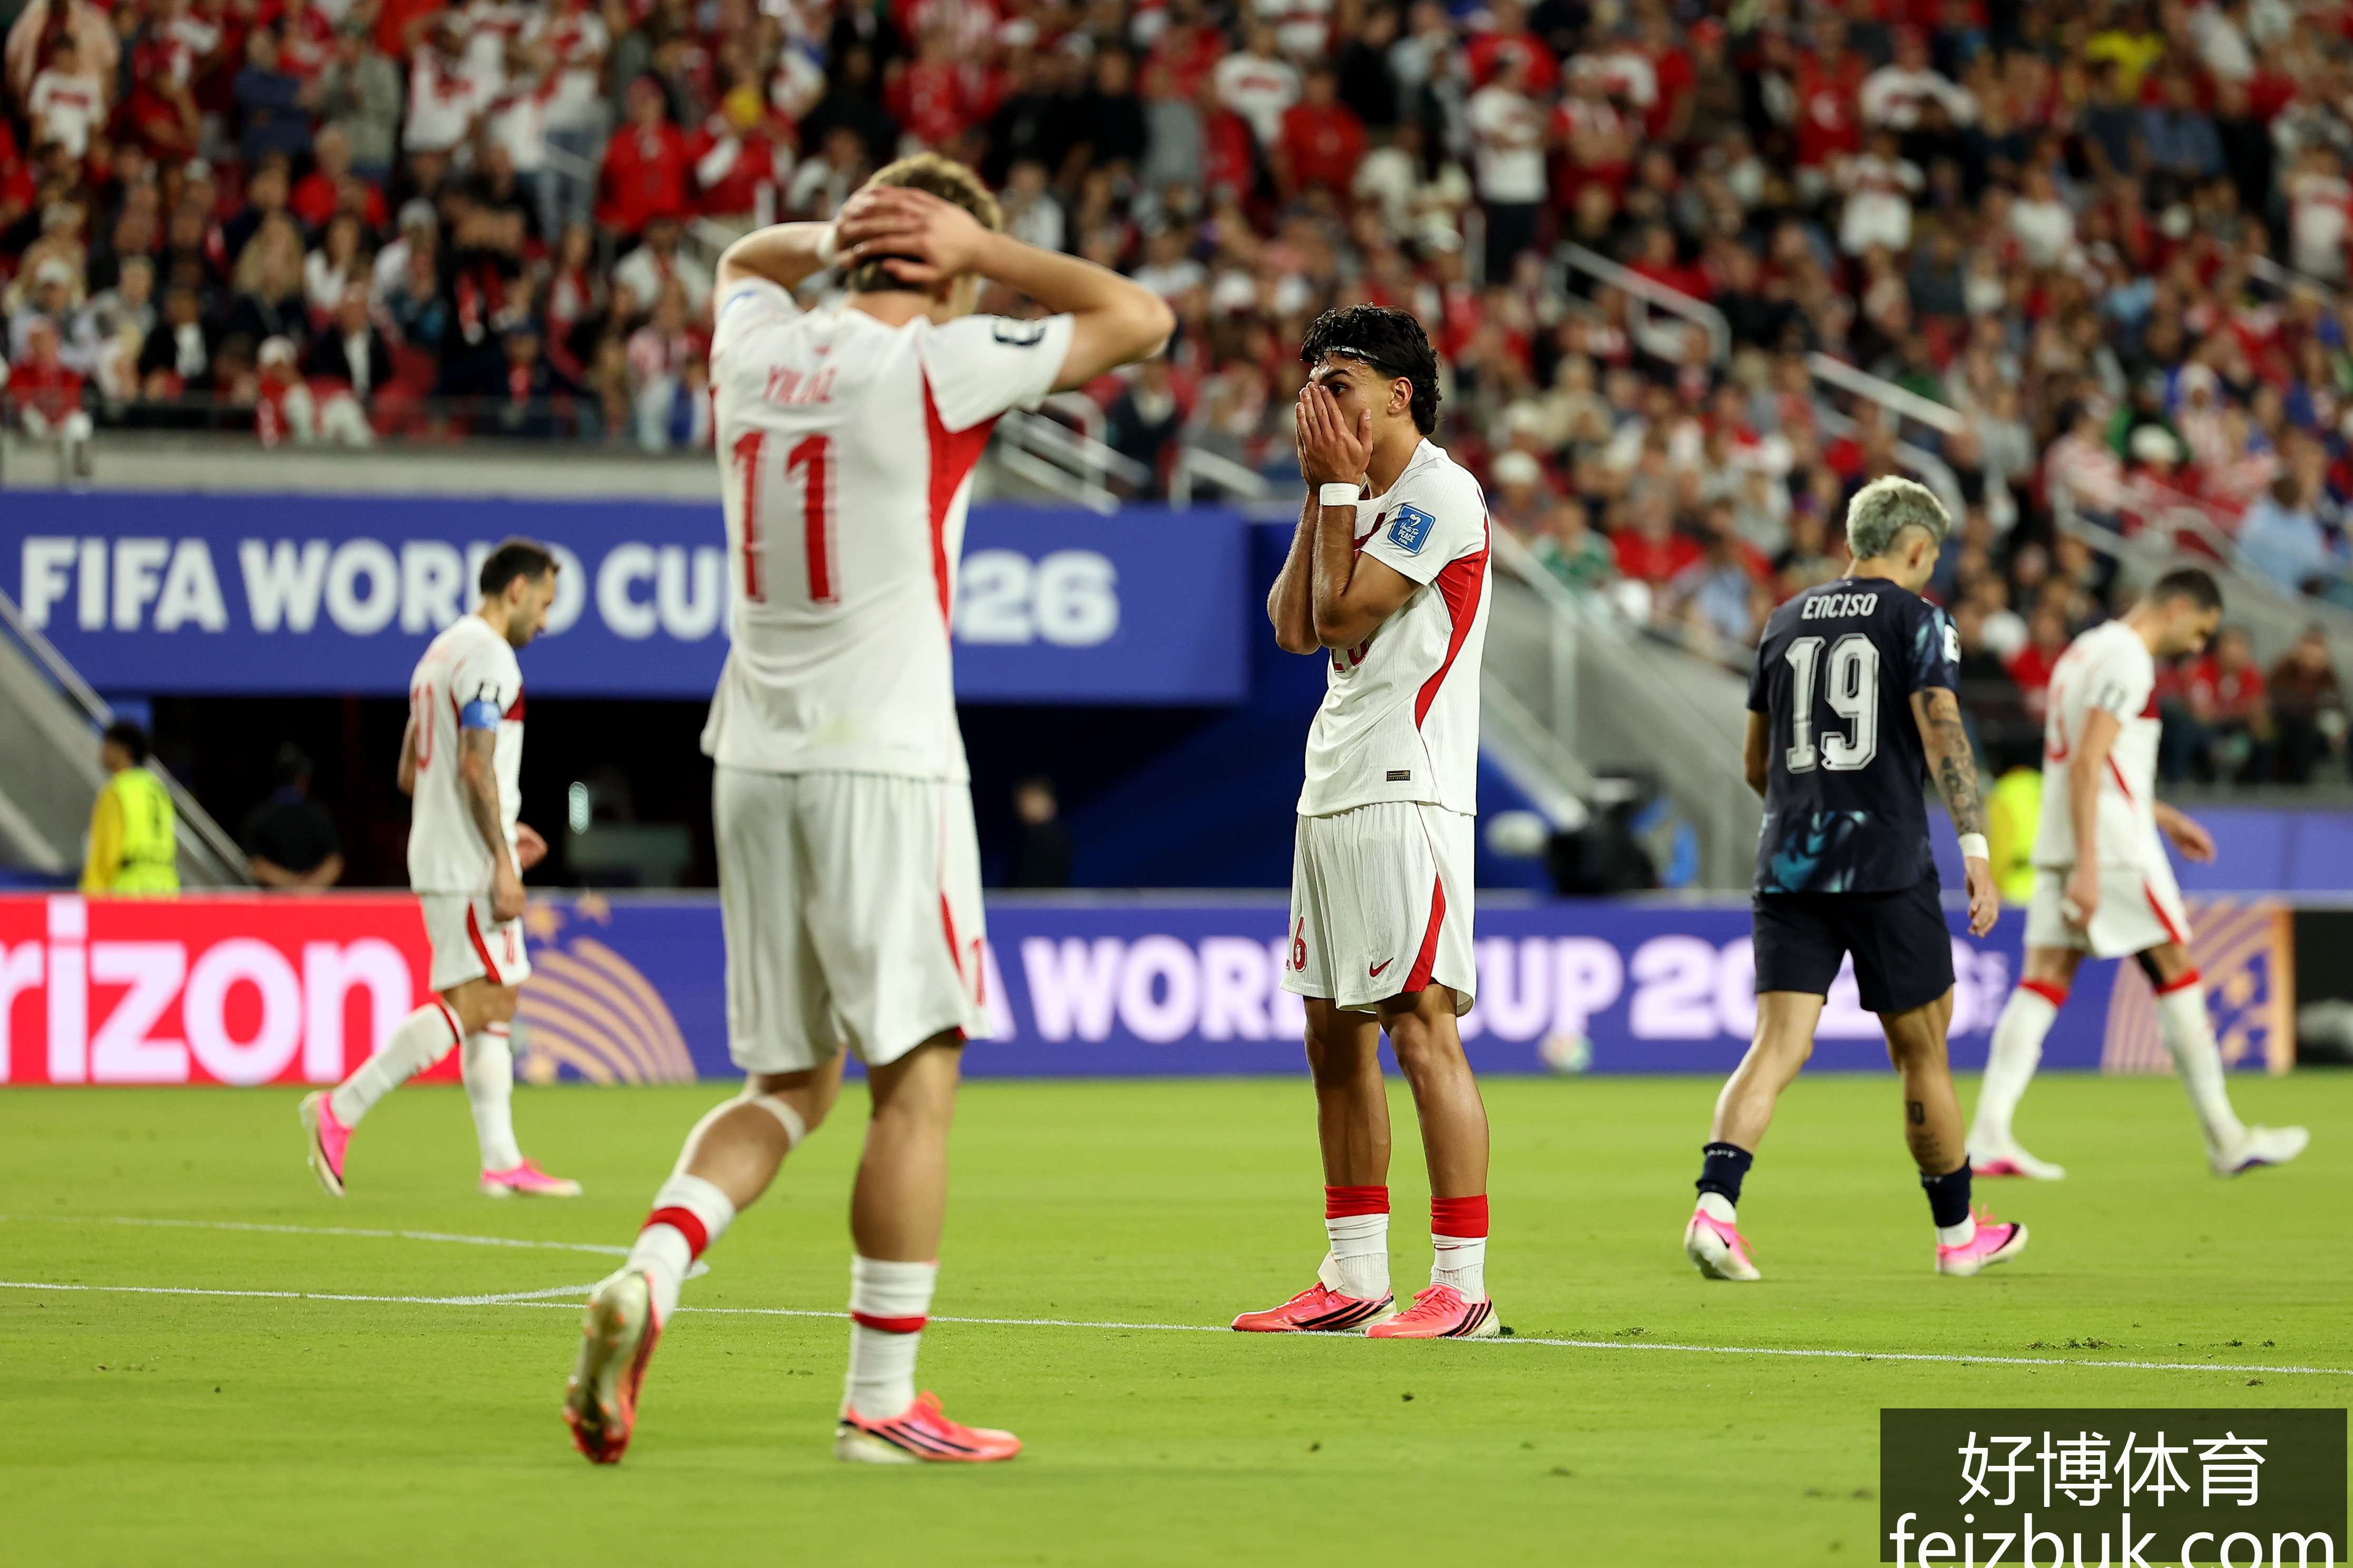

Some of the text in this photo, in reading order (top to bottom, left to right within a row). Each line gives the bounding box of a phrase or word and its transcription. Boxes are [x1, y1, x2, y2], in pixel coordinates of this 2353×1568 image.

[732, 430, 840, 604] 11
[1398, 528, 1415, 543] PEACE
[20, 536, 228, 632] FIFA
[597, 542, 731, 643] CU
[1785, 633, 1880, 773] 19
